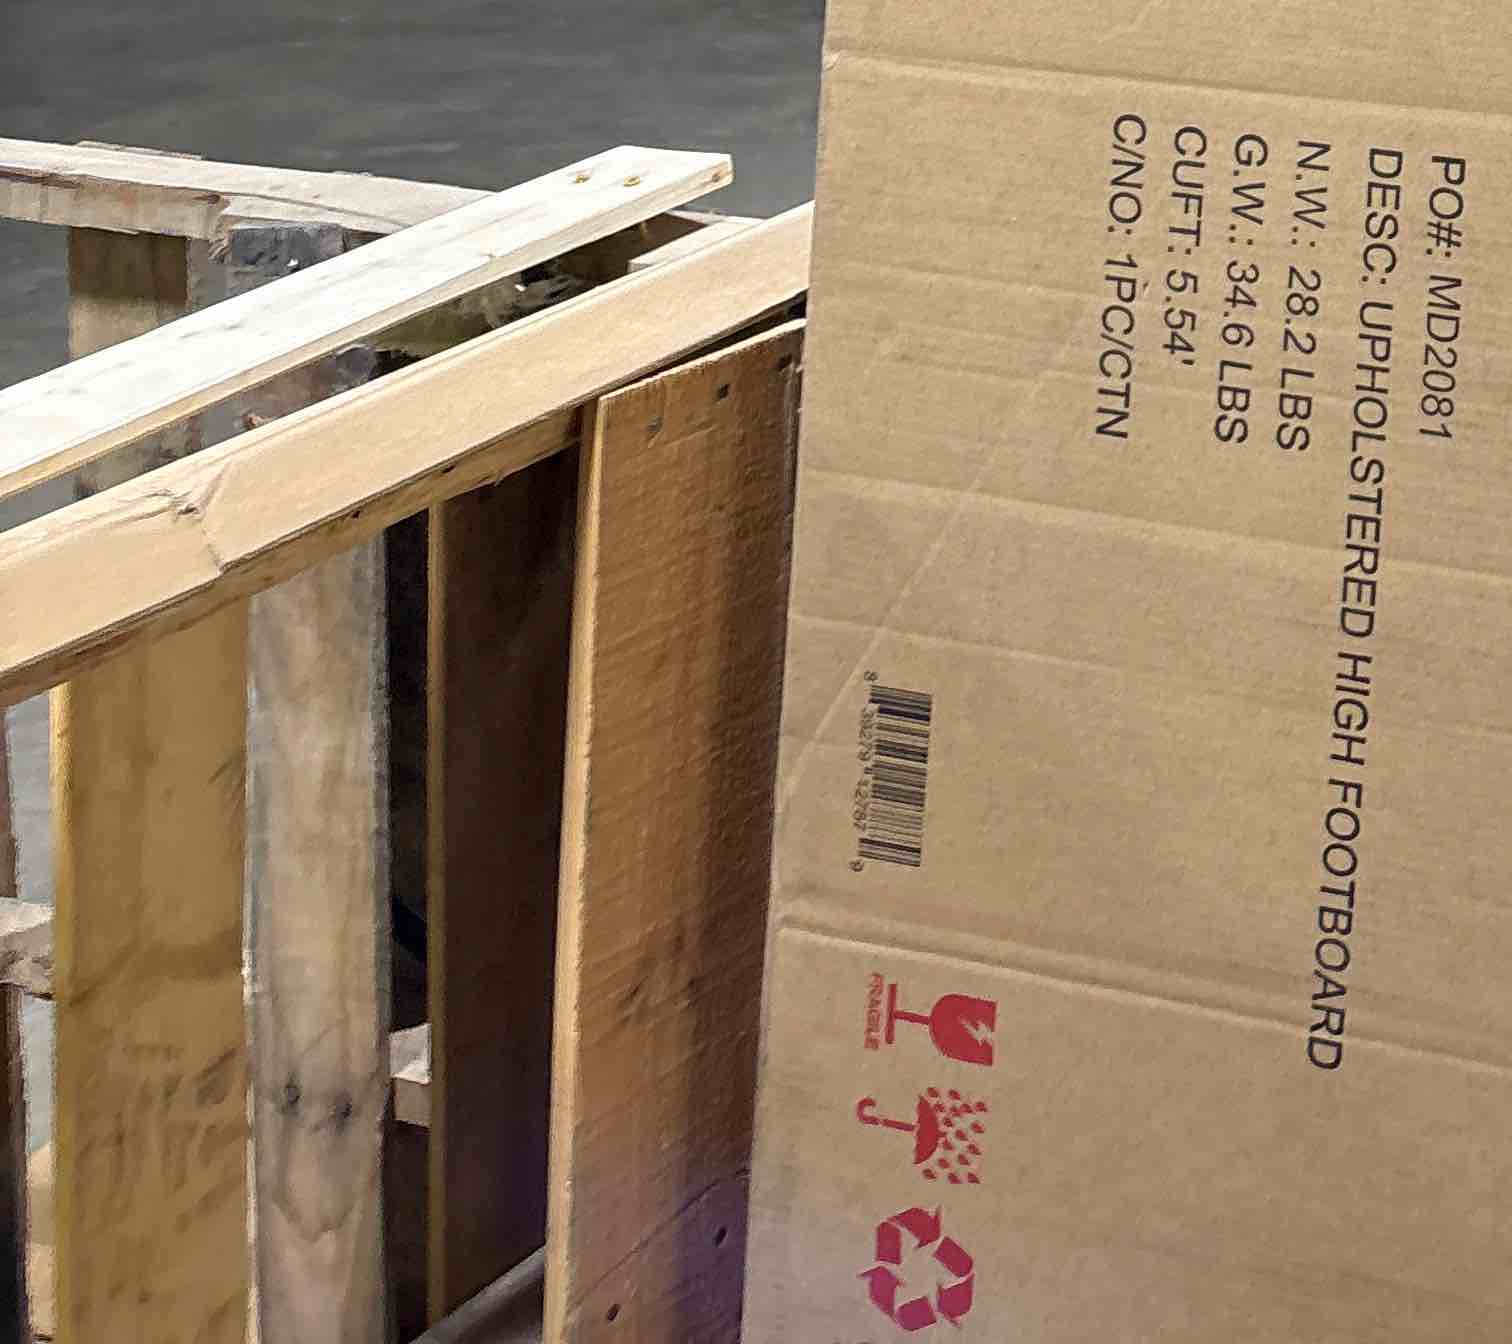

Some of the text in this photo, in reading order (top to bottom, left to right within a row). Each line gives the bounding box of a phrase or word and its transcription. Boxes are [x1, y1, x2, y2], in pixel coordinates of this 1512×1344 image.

[1096, 114, 1146, 439] C/NO: 1PC/CTN
[1163, 127, 1207, 365] CUFT: 5.54'
[1214, 134, 1268, 443] G.W.: 34.6 LBS
[1276, 141, 1331, 451] N.W.: 28.2 LBS
[1419, 156, 1466, 438] PO#: MD2081
[1307, 148, 1403, 1069] DESC: UPHOLSTERED HIGH FOOTBOARD
[863, 972, 884, 1051] FRAGILE
